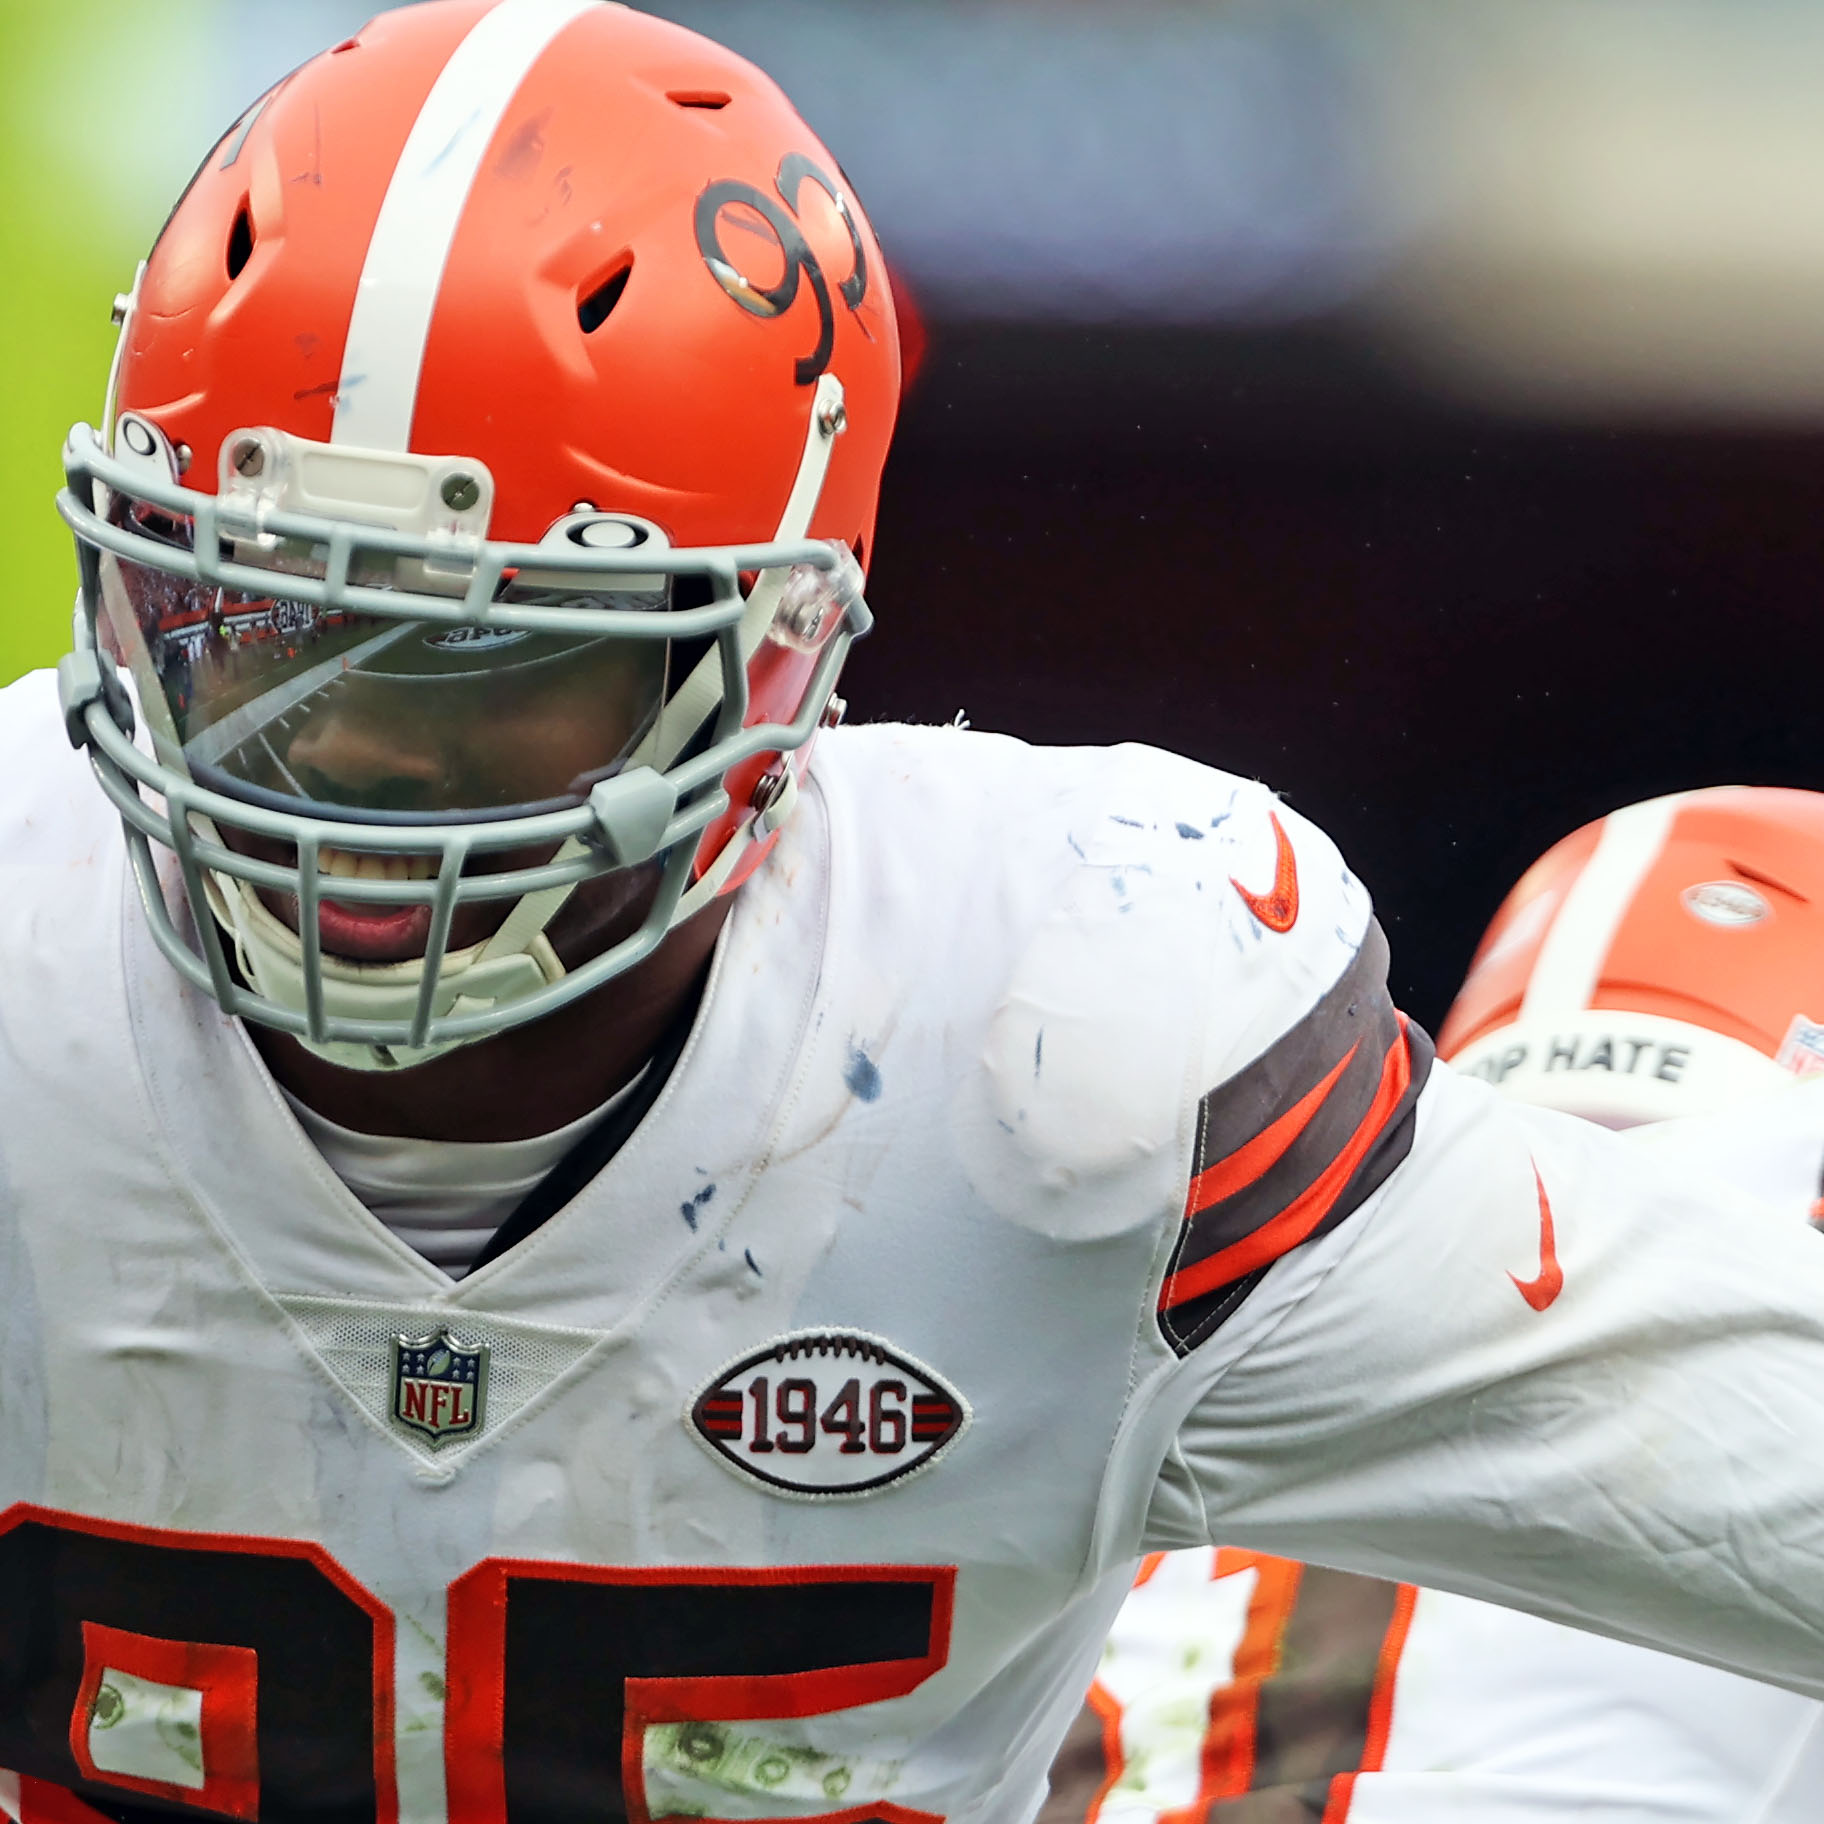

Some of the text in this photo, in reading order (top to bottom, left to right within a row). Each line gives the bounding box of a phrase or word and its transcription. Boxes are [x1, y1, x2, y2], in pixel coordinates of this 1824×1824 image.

[1458, 1034, 1691, 1084] OP HATE
[402, 1381, 470, 1429] NFL
[748, 1376, 907, 1454] 1946
